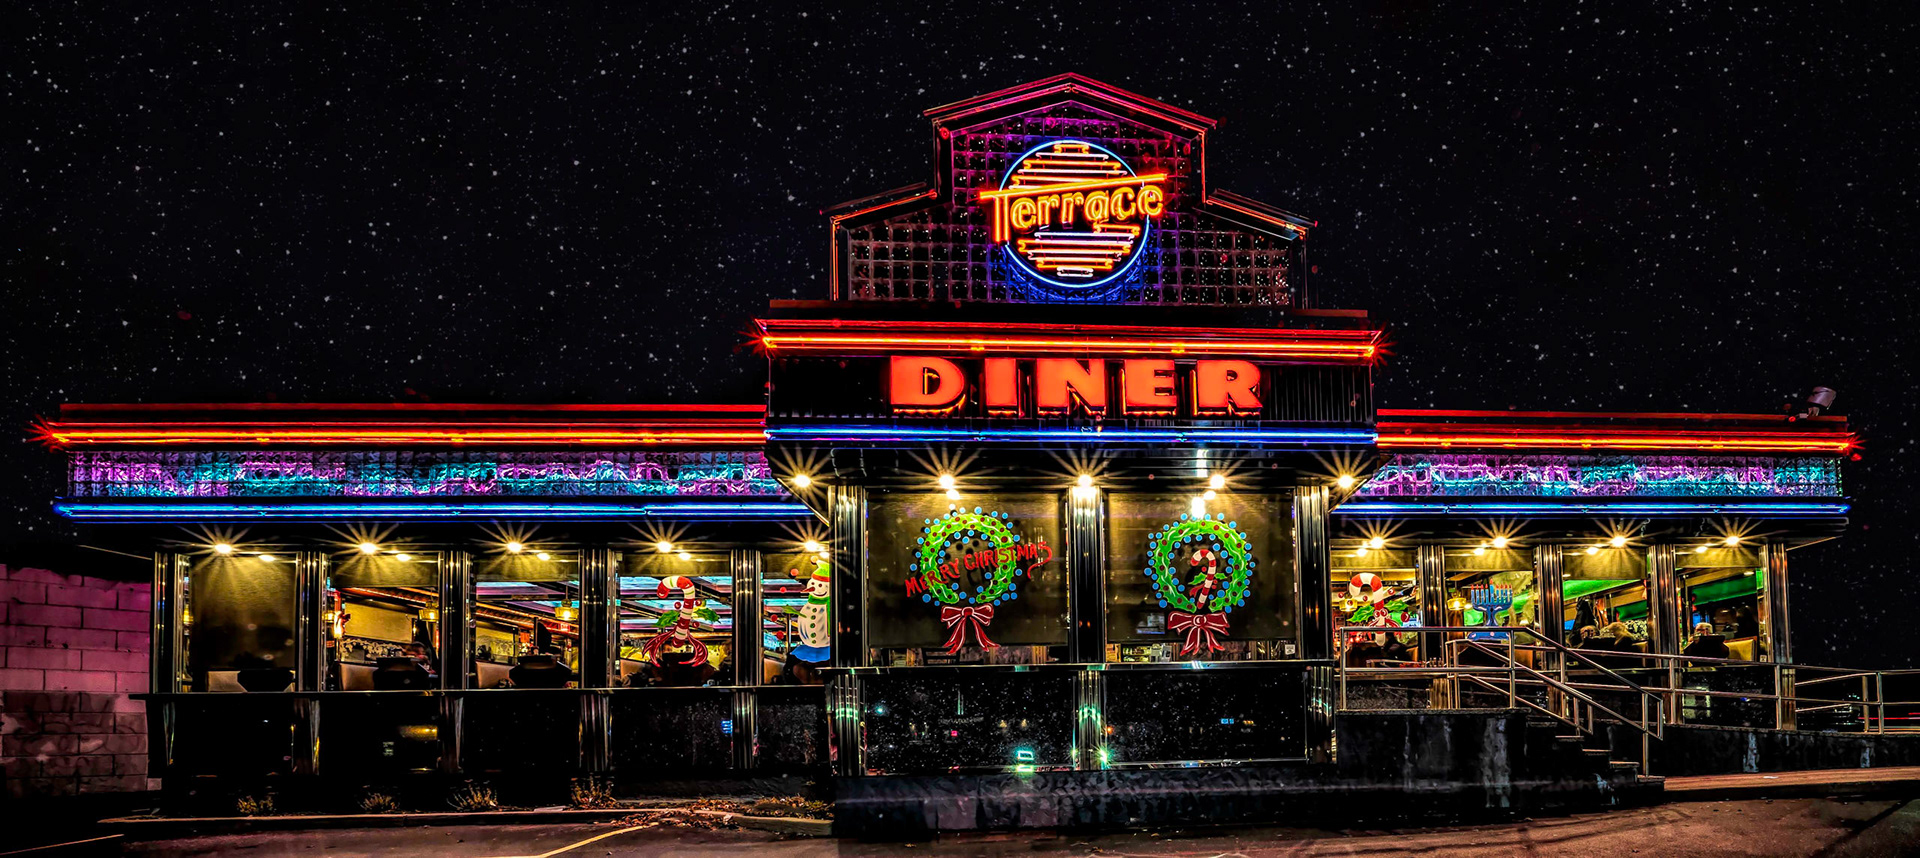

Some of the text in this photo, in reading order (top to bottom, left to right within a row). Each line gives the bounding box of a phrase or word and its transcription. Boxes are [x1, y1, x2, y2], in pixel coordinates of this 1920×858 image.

[979, 173, 1167, 242] Terrace
[890, 356, 1262, 413] DINER
[904, 541, 1052, 598] MERRY CHRISTMAS
